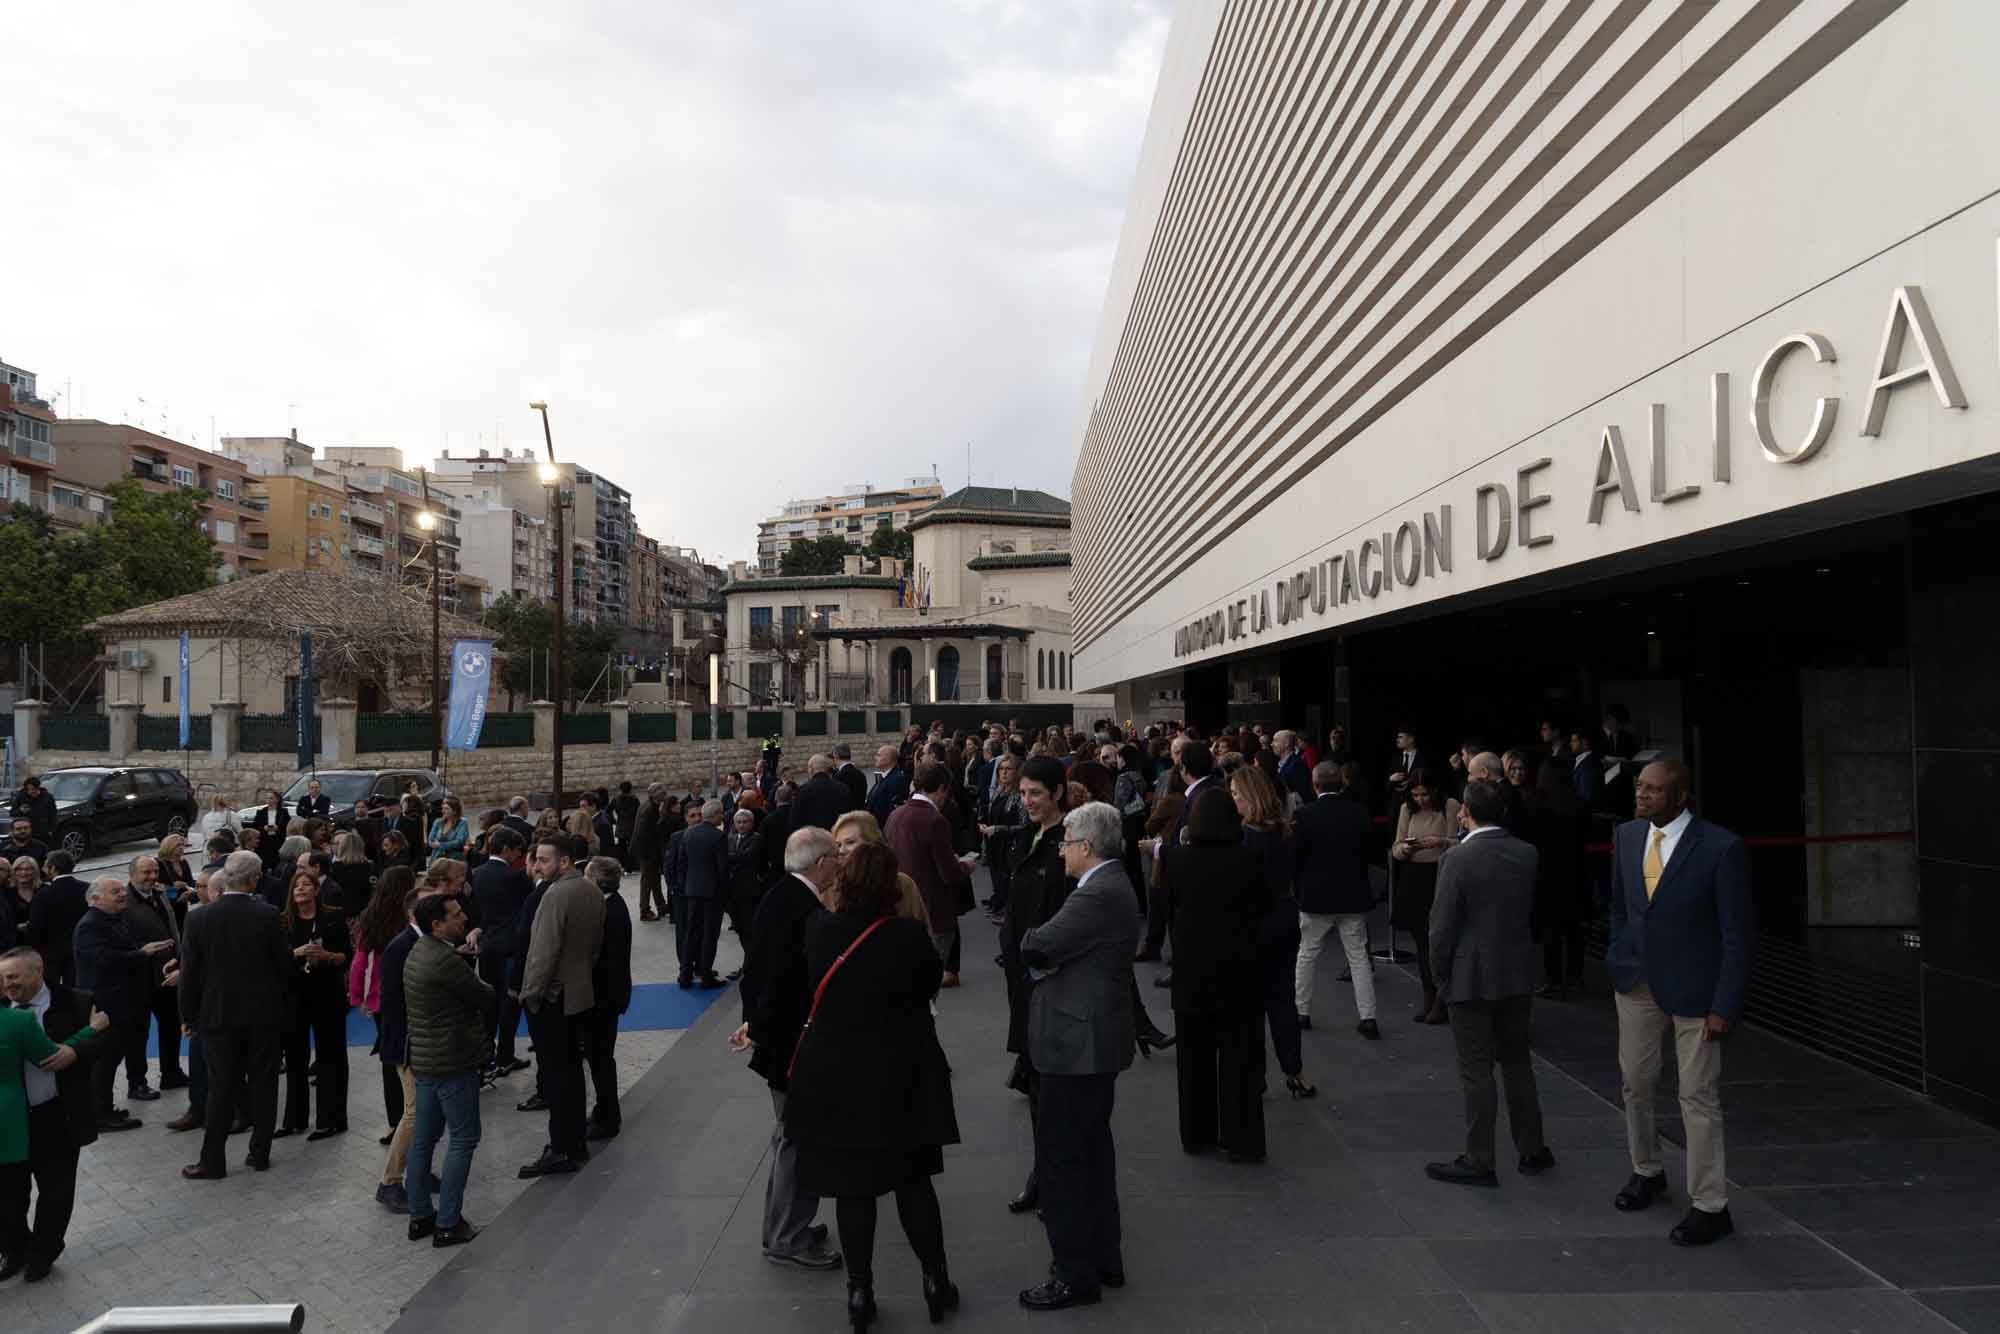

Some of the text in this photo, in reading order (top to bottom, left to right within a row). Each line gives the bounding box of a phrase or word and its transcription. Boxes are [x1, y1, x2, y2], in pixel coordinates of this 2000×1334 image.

[1228, 599, 1247, 640] DE
[1250, 589, 1272, 634] LA
[1277, 504, 1452, 625] DIPUTACION
[1476, 457, 1554, 561] DE
[1587, 237, 2000, 524] ALICA
